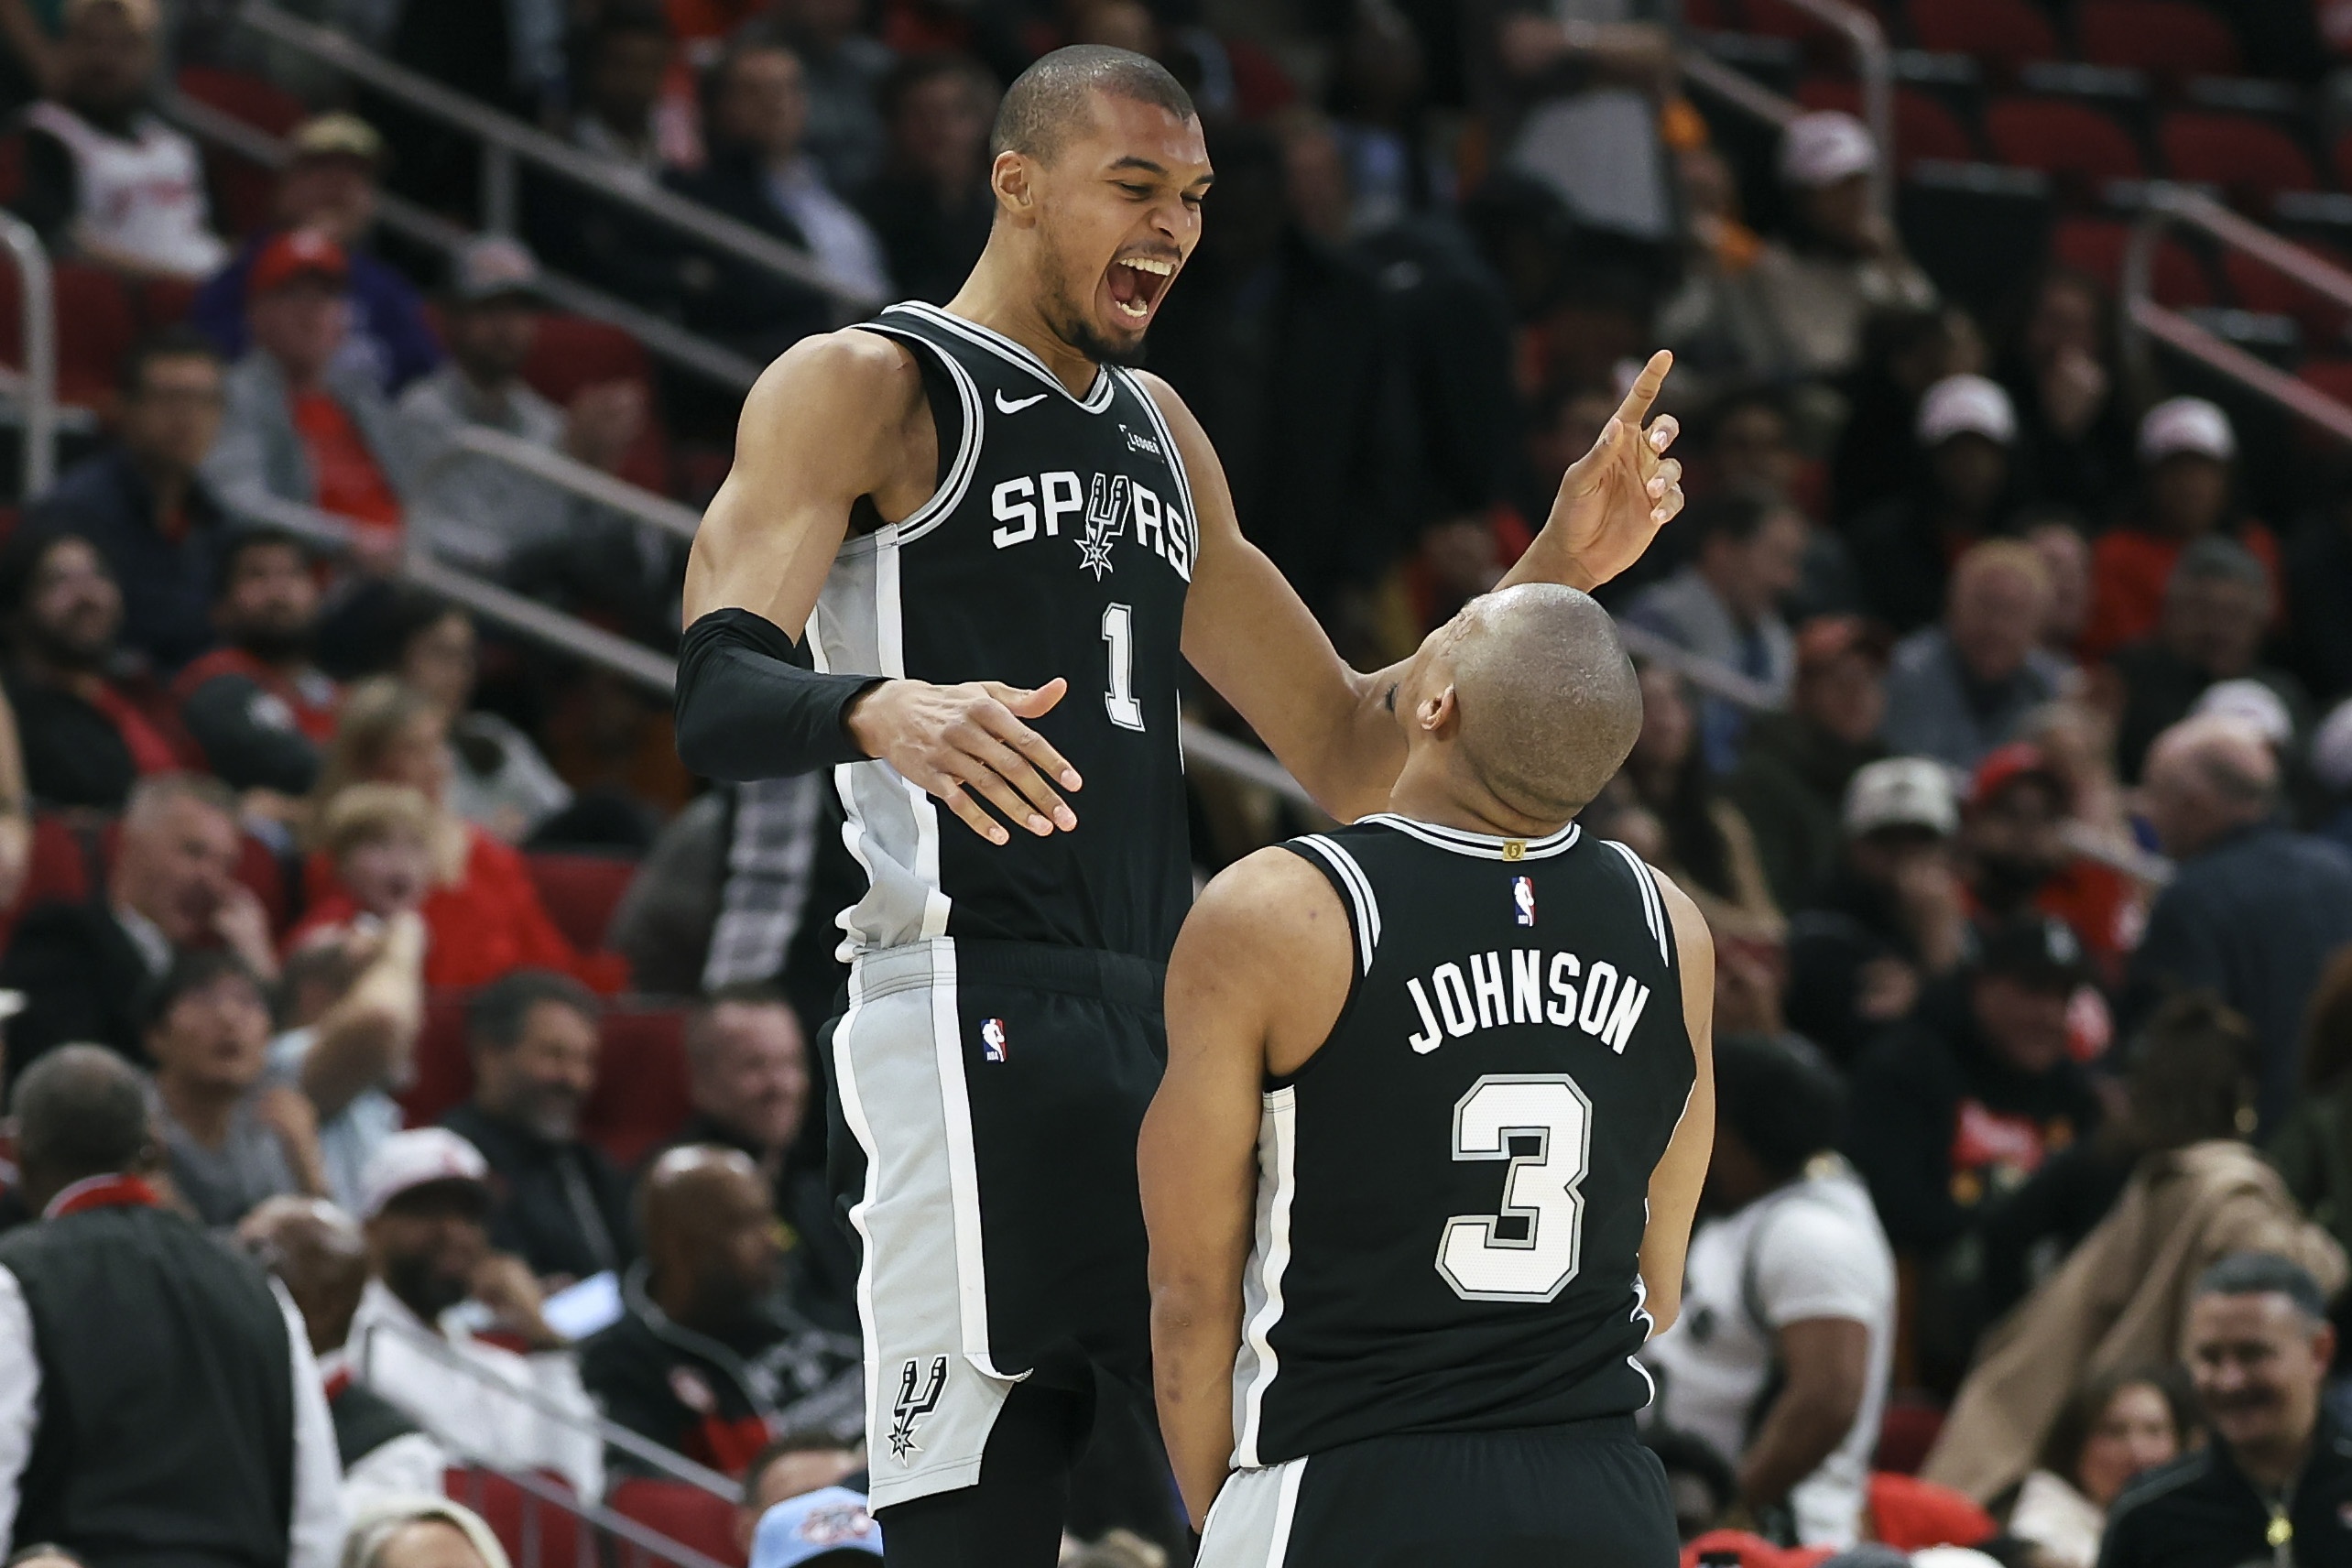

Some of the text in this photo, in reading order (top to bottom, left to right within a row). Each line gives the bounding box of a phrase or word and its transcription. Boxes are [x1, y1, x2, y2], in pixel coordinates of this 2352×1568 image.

[991, 471, 1192, 583] SPURS
[1102, 602, 1146, 733] 1
[1406, 949, 1650, 1055] JOHNSON
[1434, 1073, 1593, 1303] 3
